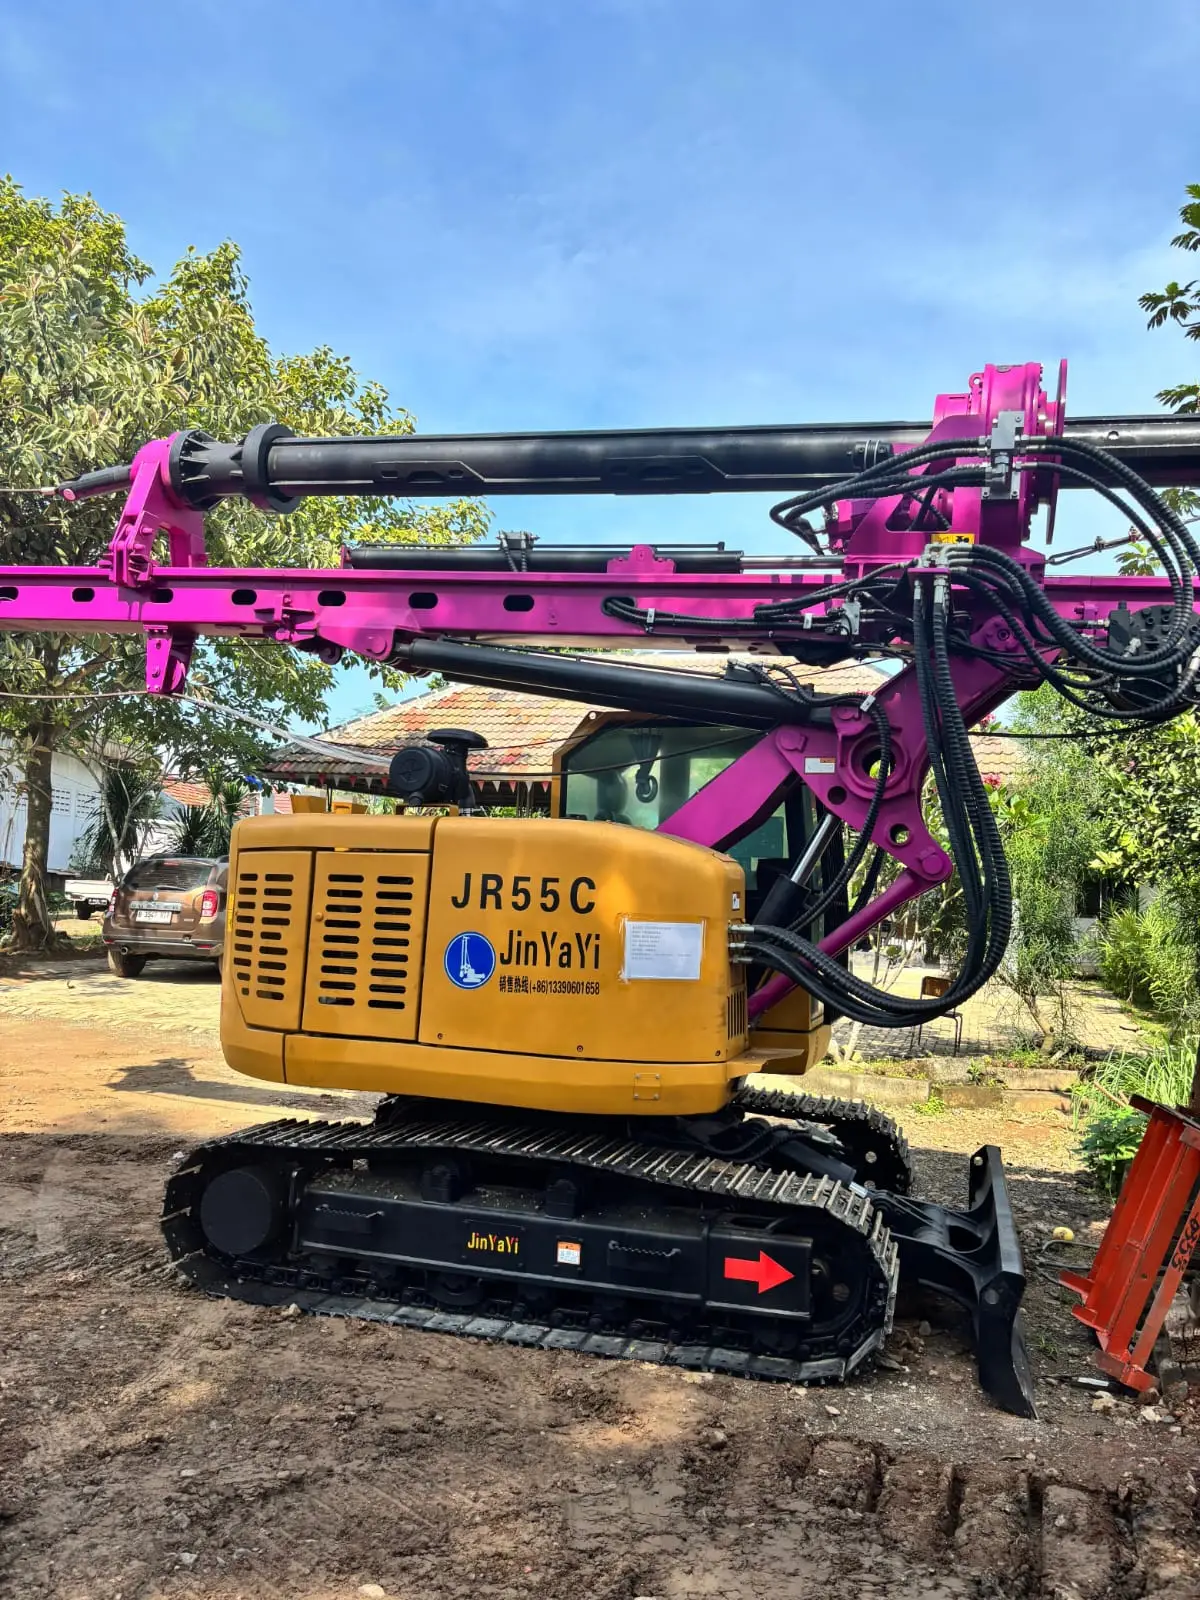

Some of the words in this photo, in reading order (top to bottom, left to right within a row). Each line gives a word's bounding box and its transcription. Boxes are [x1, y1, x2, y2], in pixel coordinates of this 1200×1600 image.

[451, 873, 596, 914] JR55C
[500, 929, 601, 970] JinYaYi
[467, 1232, 519, 1254] JinYaYi
